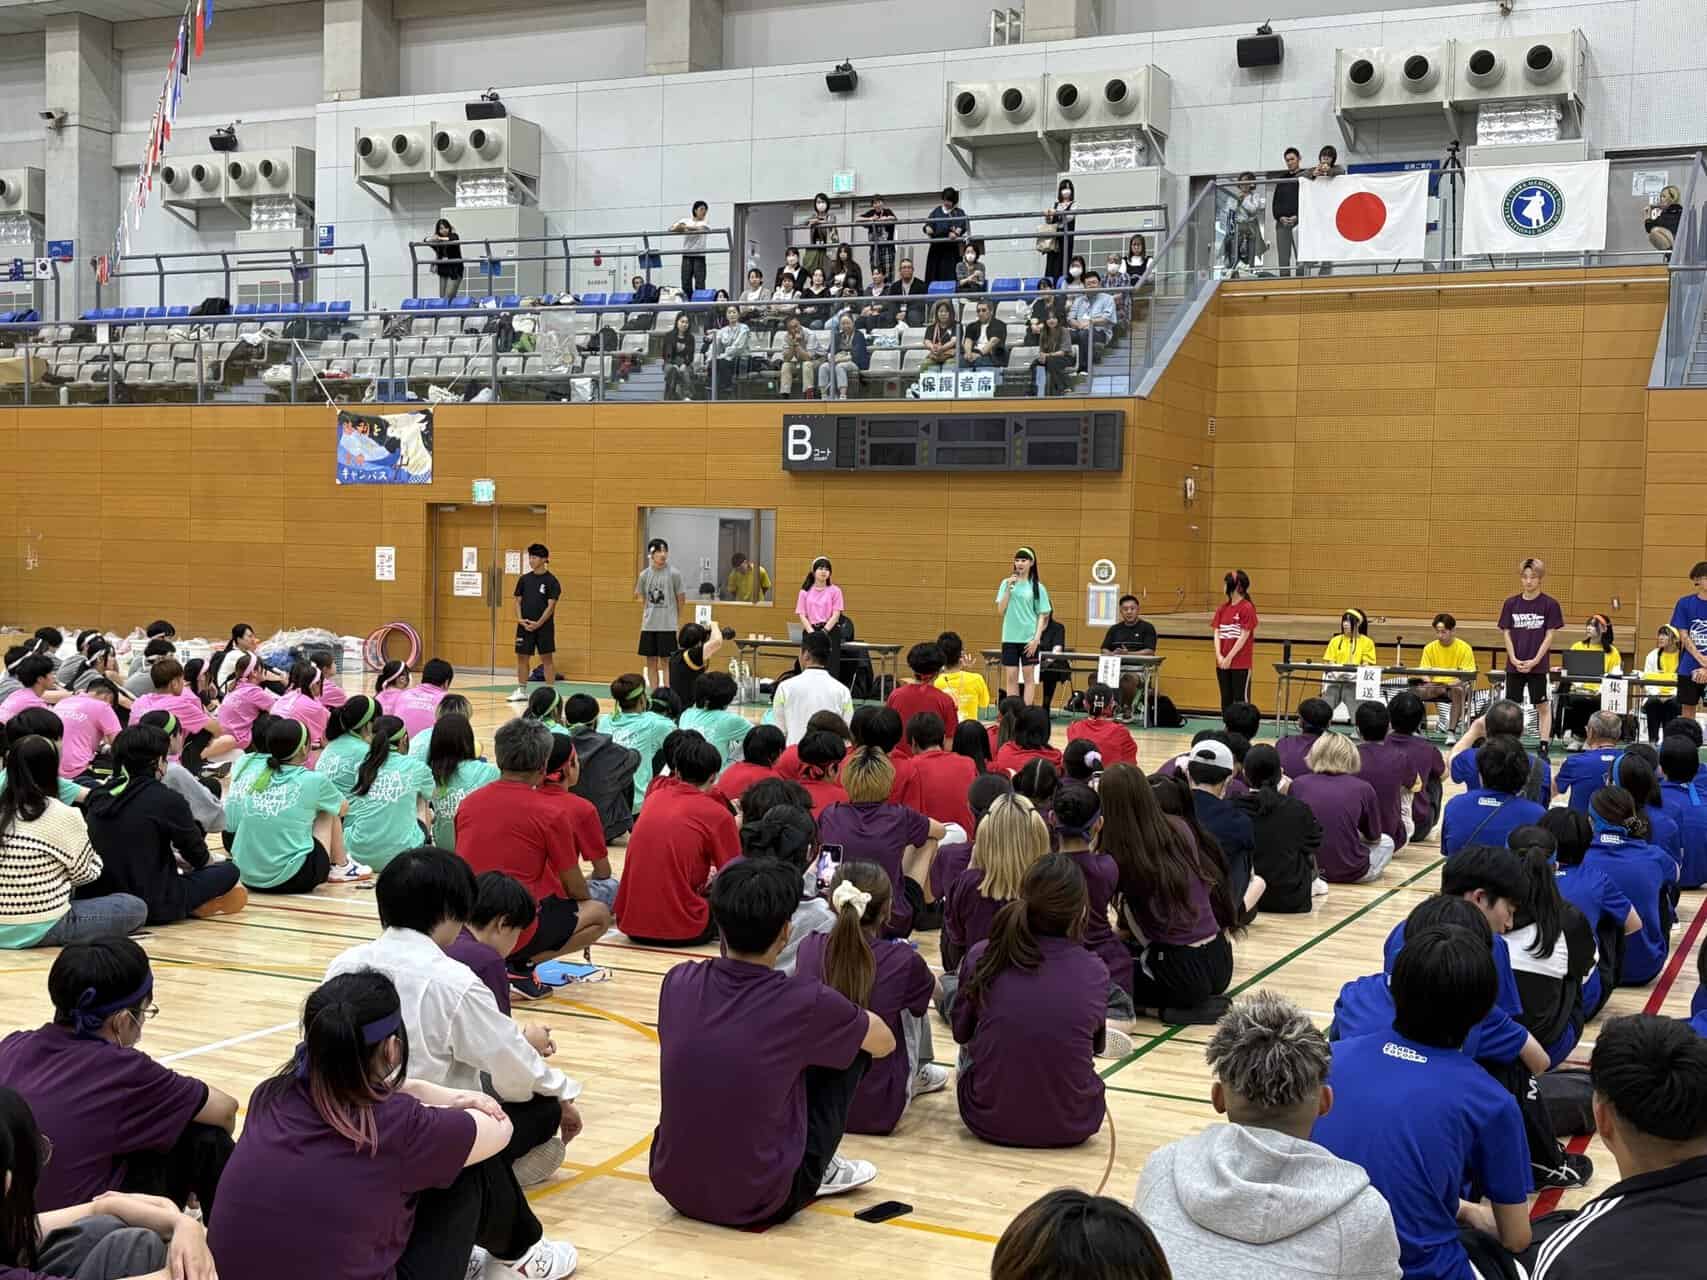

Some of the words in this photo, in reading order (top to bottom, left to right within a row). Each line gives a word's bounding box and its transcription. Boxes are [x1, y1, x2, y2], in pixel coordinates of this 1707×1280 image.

[922, 376, 992, 393] 保護者席
[788, 424, 812, 460] B
